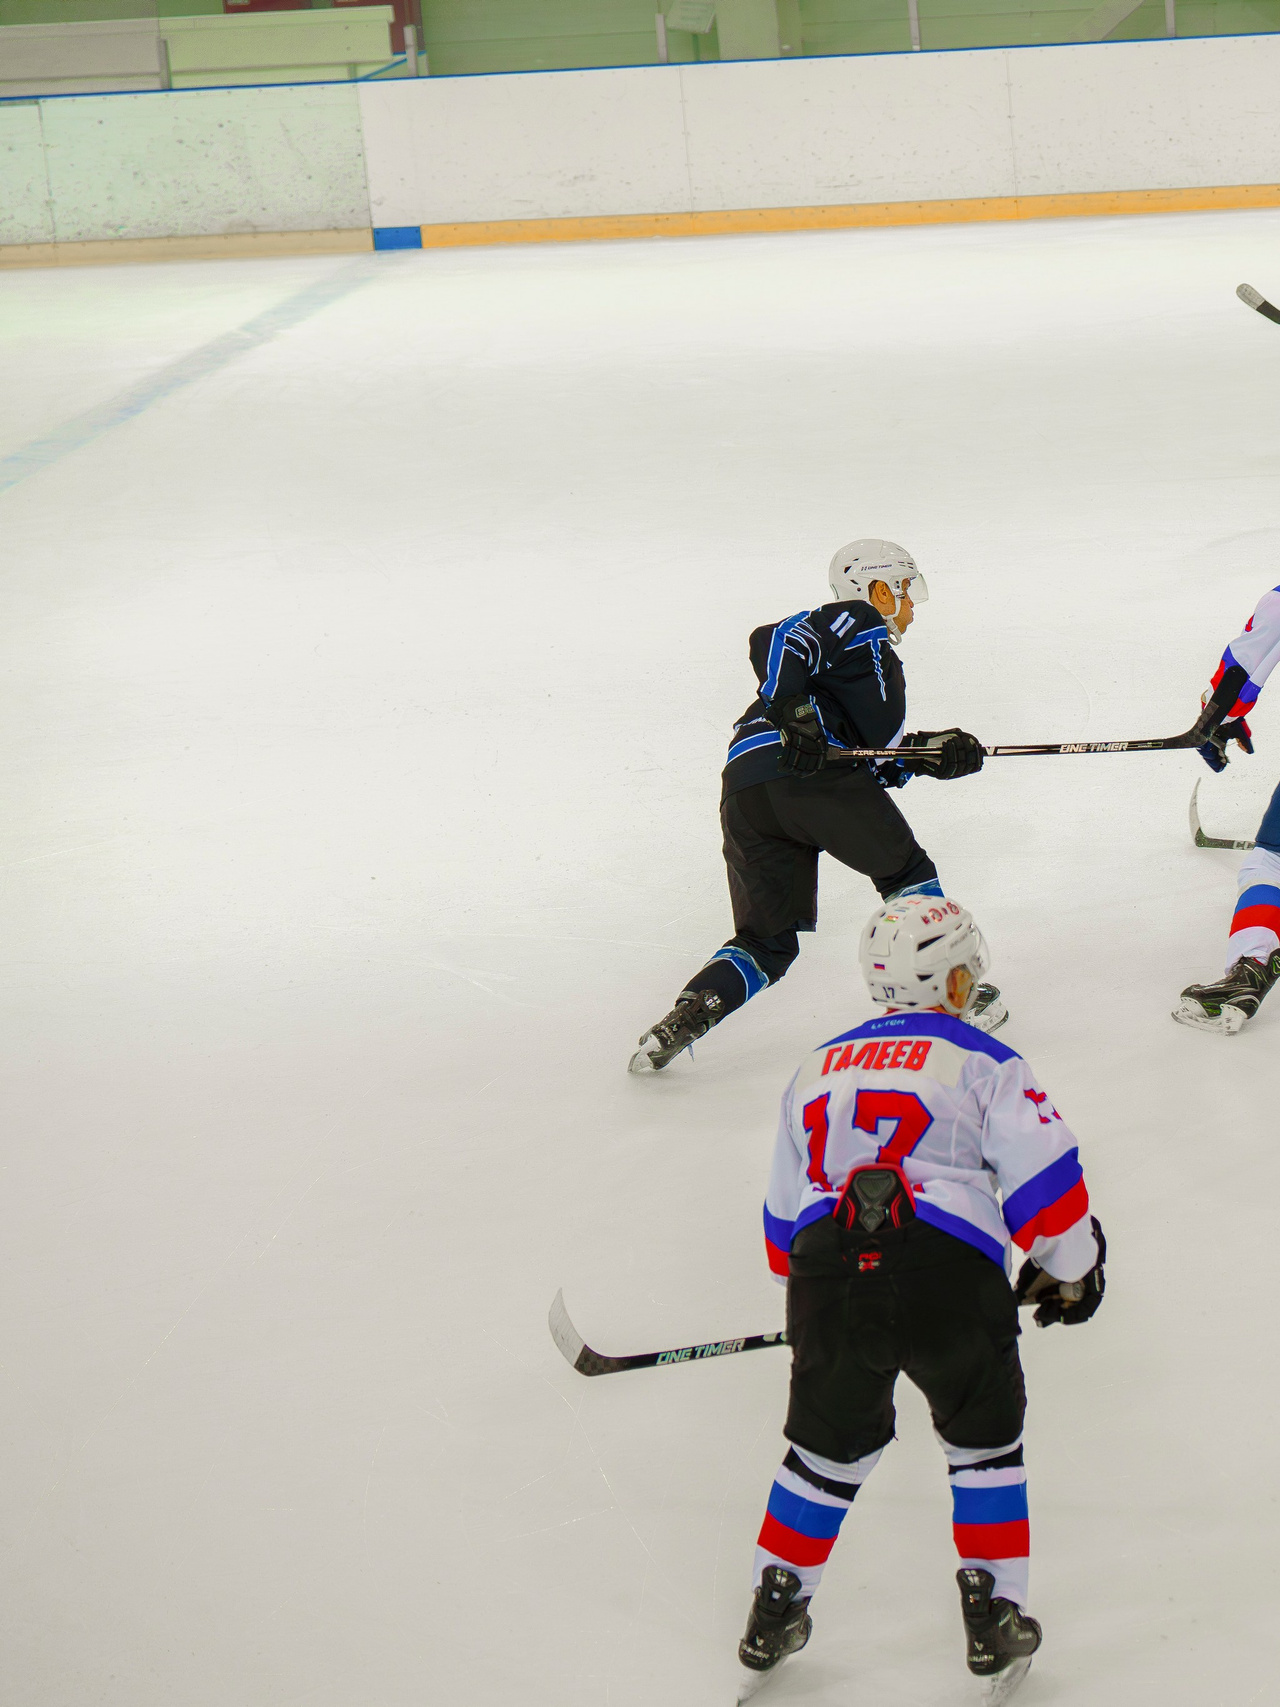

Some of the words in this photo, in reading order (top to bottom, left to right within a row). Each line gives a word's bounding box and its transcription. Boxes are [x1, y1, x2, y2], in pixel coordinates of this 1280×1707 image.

[1089, 742, 1129, 752] TIMER
[882, 985, 896, 1000] 17
[820, 1040, 933, 1077] ГАЛЕЕВ
[803, 1088, 935, 1186] 17
[656, 1347, 693, 1367] ONE
[694, 1337, 746, 1359] TIMER
